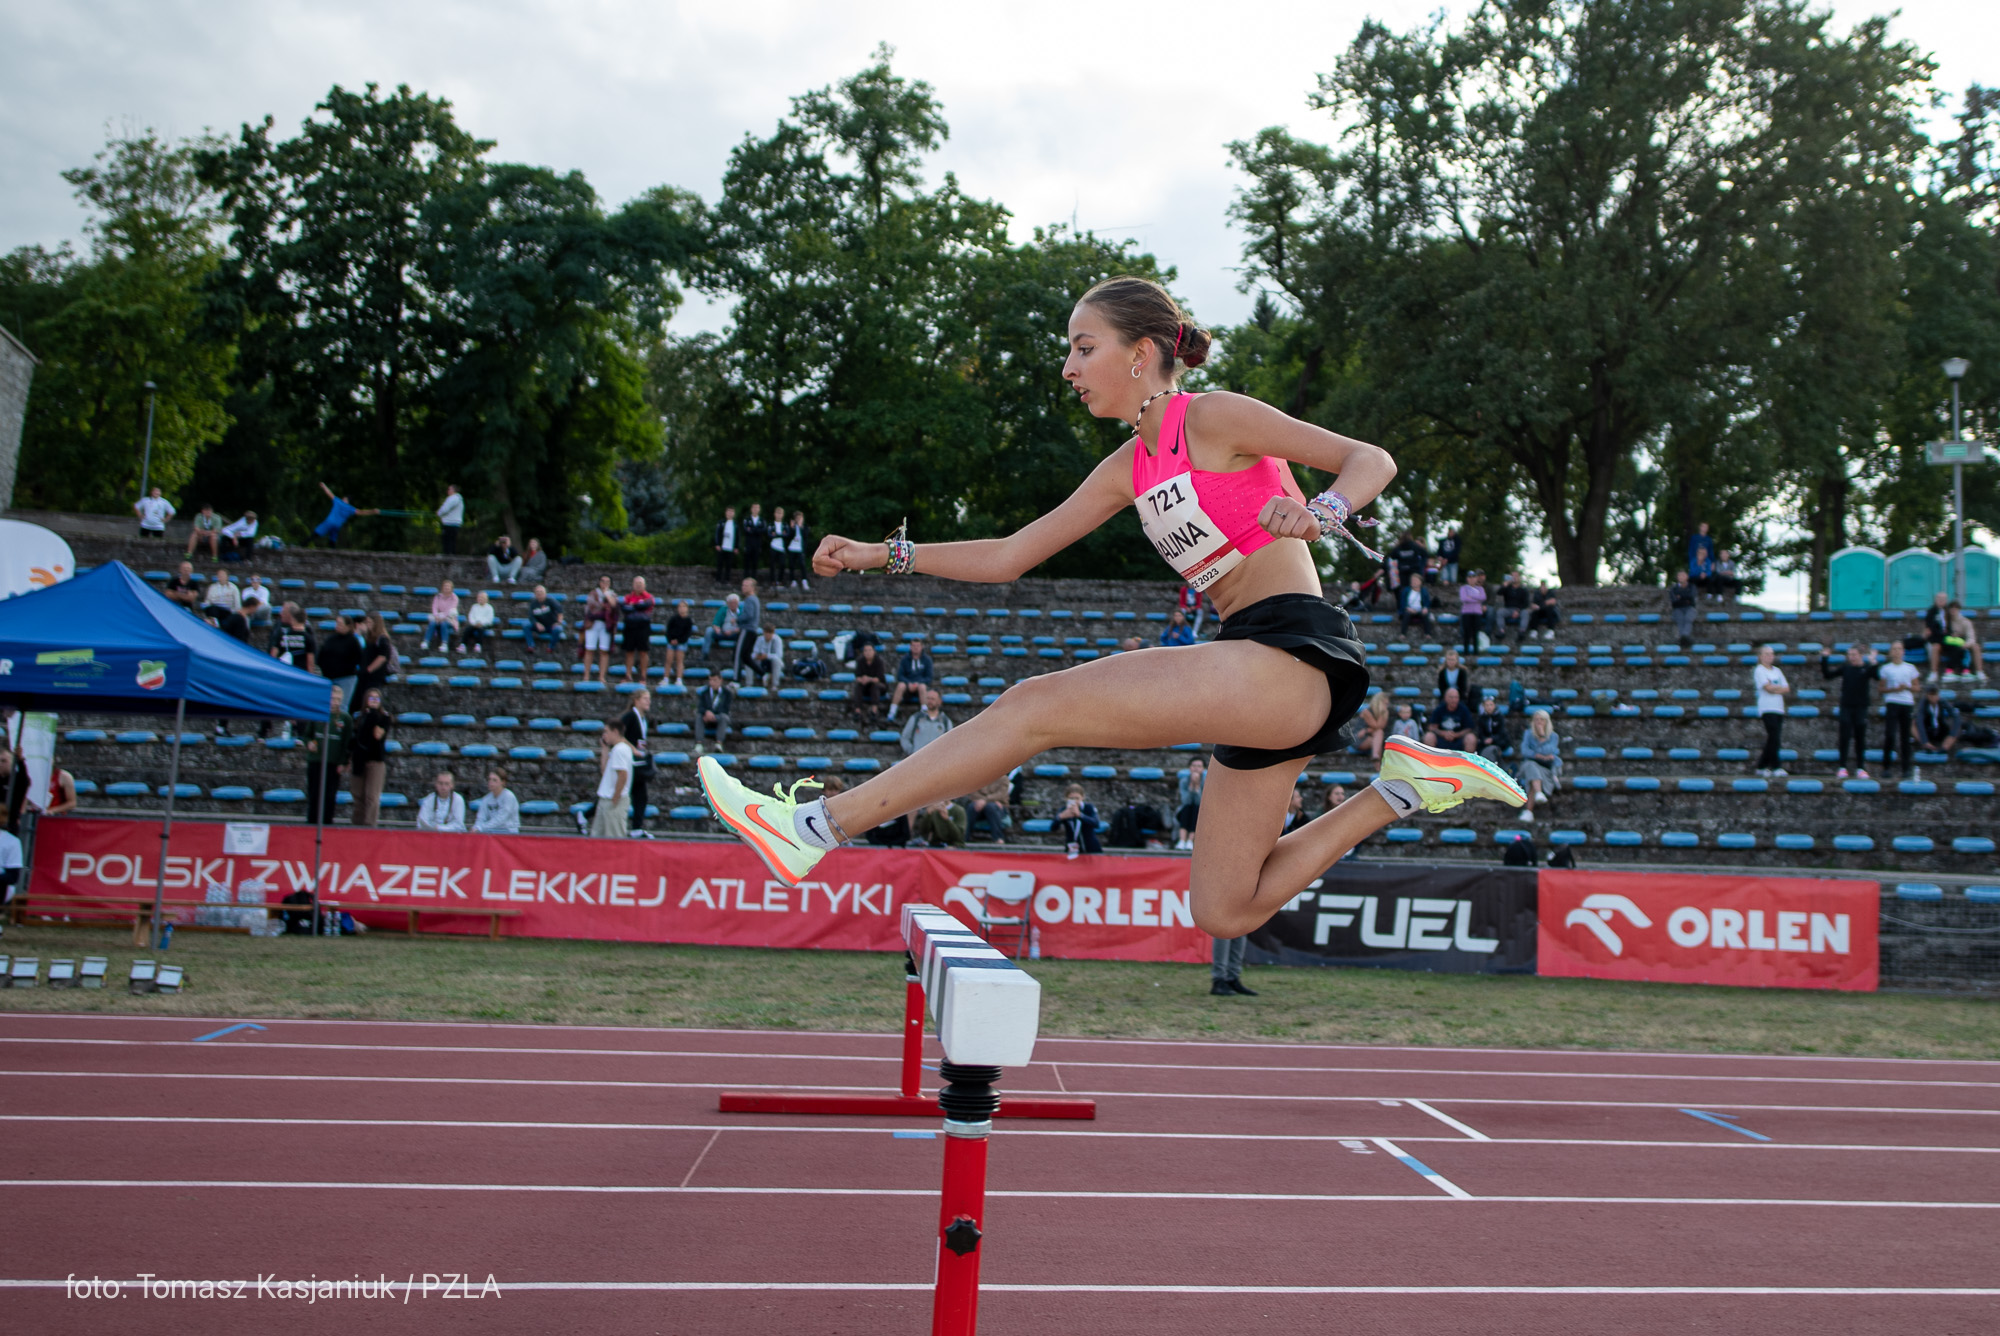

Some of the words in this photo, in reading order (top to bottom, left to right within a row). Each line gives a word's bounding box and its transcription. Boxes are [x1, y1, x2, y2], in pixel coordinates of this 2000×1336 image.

[1148, 482, 1186, 517] 721
[1197, 567, 1219, 585] 2023
[60, 852, 234, 888] POLSKI
[481, 868, 666, 906] LEKKIEJ
[679, 877, 893, 915] ATLETYKI
[1033, 884, 1196, 928] ORLEN
[1667, 906, 1850, 954] ORLEN
